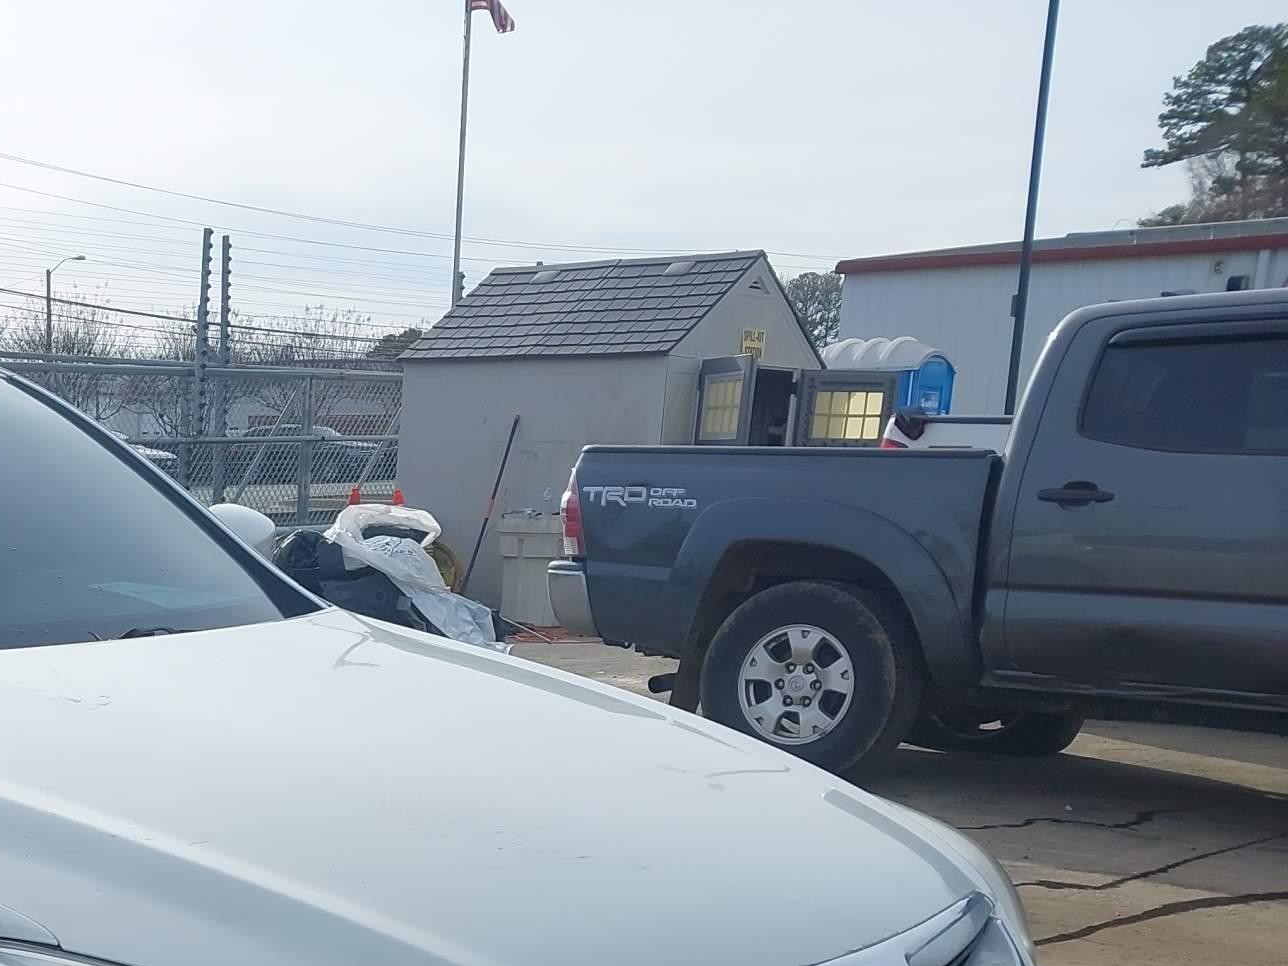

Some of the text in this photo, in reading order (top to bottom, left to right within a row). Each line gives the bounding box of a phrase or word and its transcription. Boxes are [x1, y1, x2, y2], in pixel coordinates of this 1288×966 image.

[582, 486, 647, 506] TRD
[650, 488, 688, 497] OFF
[648, 498, 697, 508] ROAD
